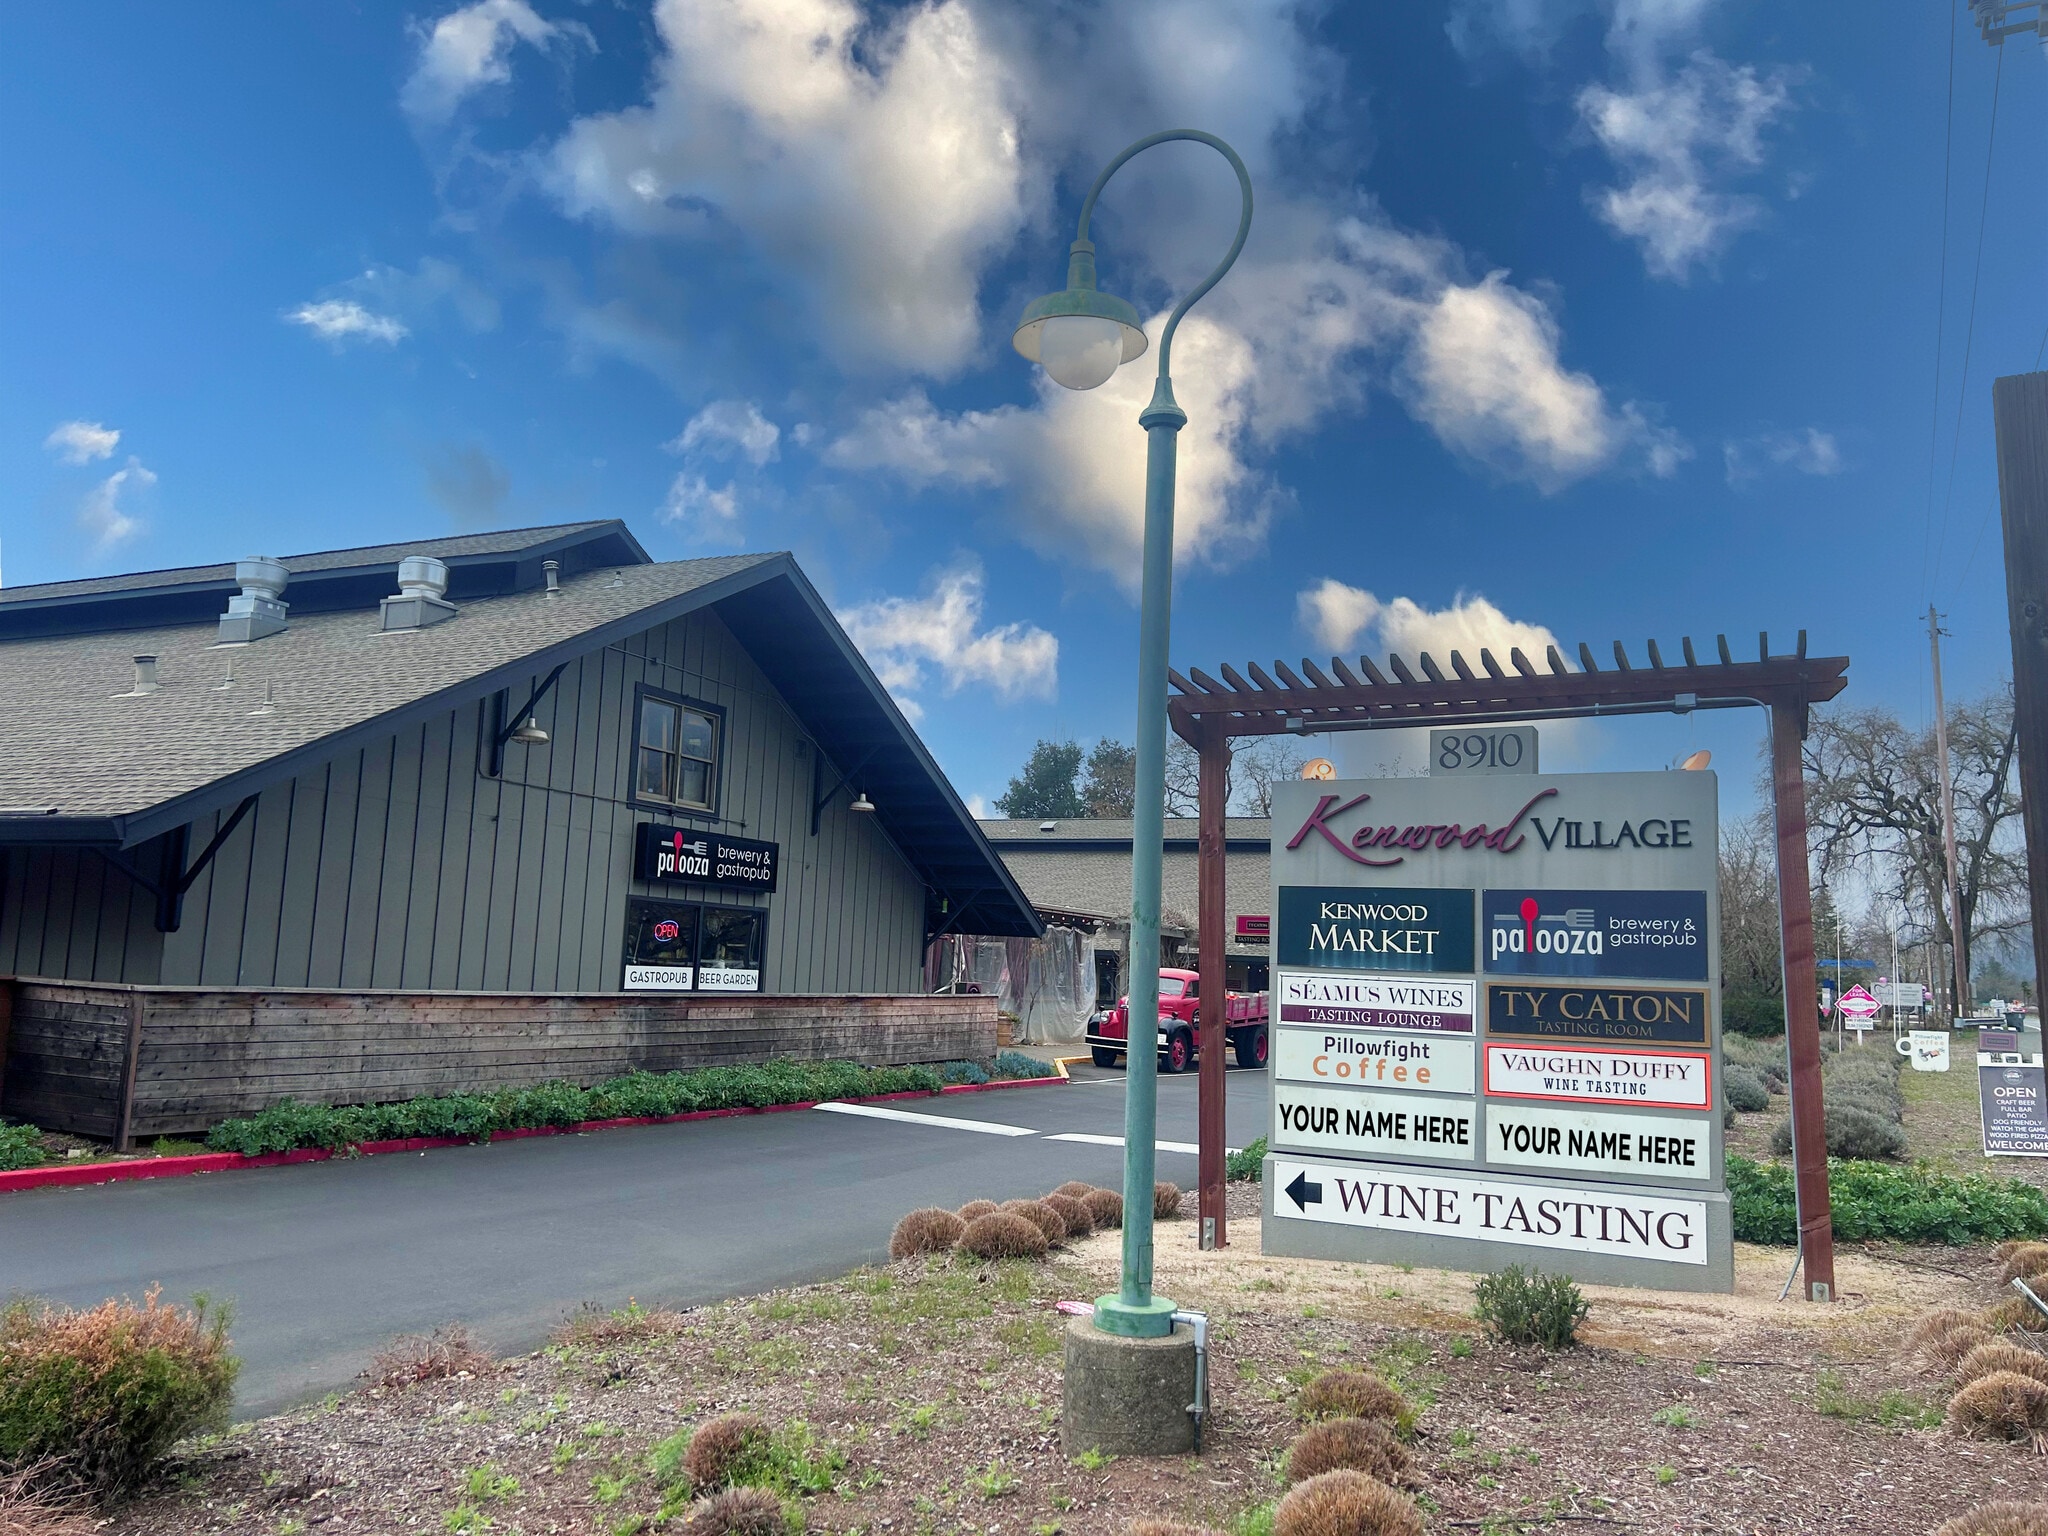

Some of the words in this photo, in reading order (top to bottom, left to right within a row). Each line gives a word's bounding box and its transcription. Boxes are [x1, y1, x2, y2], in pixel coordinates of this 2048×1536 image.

[1439, 733, 1523, 770] 8910
[1285, 788, 1558, 866] Kenwood
[1530, 816, 1692, 851] VILLAGE
[657, 831, 709, 877] palooza
[718, 844, 762, 865] brewery
[763, 851, 771, 865] &
[717, 863, 771, 881] gastropub
[1320, 902, 1428, 922] KENWOOD
[654, 923, 678, 938] OPEN
[1492, 898, 1603, 960] palooza
[1609, 917, 1681, 934] brewery
[1683, 918, 1695, 931] &
[1309, 923, 1440, 955] MARKET
[1609, 932, 1697, 948] gastropub
[630, 971, 688, 984] GASTROPUB
[700, 972, 721, 985] BEER
[723, 973, 757, 985] GARDEN
[1288, 979, 1381, 1005] SÉAMUS
[1388, 987, 1464, 1008] WINES
[1308, 1008, 1372, 1024] TASTING
[1378, 1012, 1442, 1028] LOUNGE
[1499, 991, 1549, 1018] TY
[1557, 993, 1693, 1025] CATON
[1535, 1021, 1603, 1036] TASTING
[1605, 1023, 1653, 1038] ROOM
[1324, 1036, 1431, 1061] Pillowfight
[1312, 1056, 1431, 1084] Coffee
[1500, 1053, 1602, 1077] VAUGHN
[1609, 1059, 1691, 1081] DUFFY
[1543, 1078, 1579, 1092] WINE
[1586, 1080, 1647, 1096] TASTING
[1994, 1087, 2037, 1098] OPEN
[1279, 1104, 1339, 1134] YOUR
[1346, 1109, 1406, 1140] NAME
[1414, 1115, 1469, 1146] HERE
[1499, 1123, 1561, 1155] YOUR
[1568, 1129, 1631, 1161] NAME
[1638, 1135, 1695, 1166] HERE
[1988, 1140, 2048, 1150] WELCOME
[1334, 1178, 1461, 1225] WINE
[1472, 1193, 1694, 1250] TASTING
